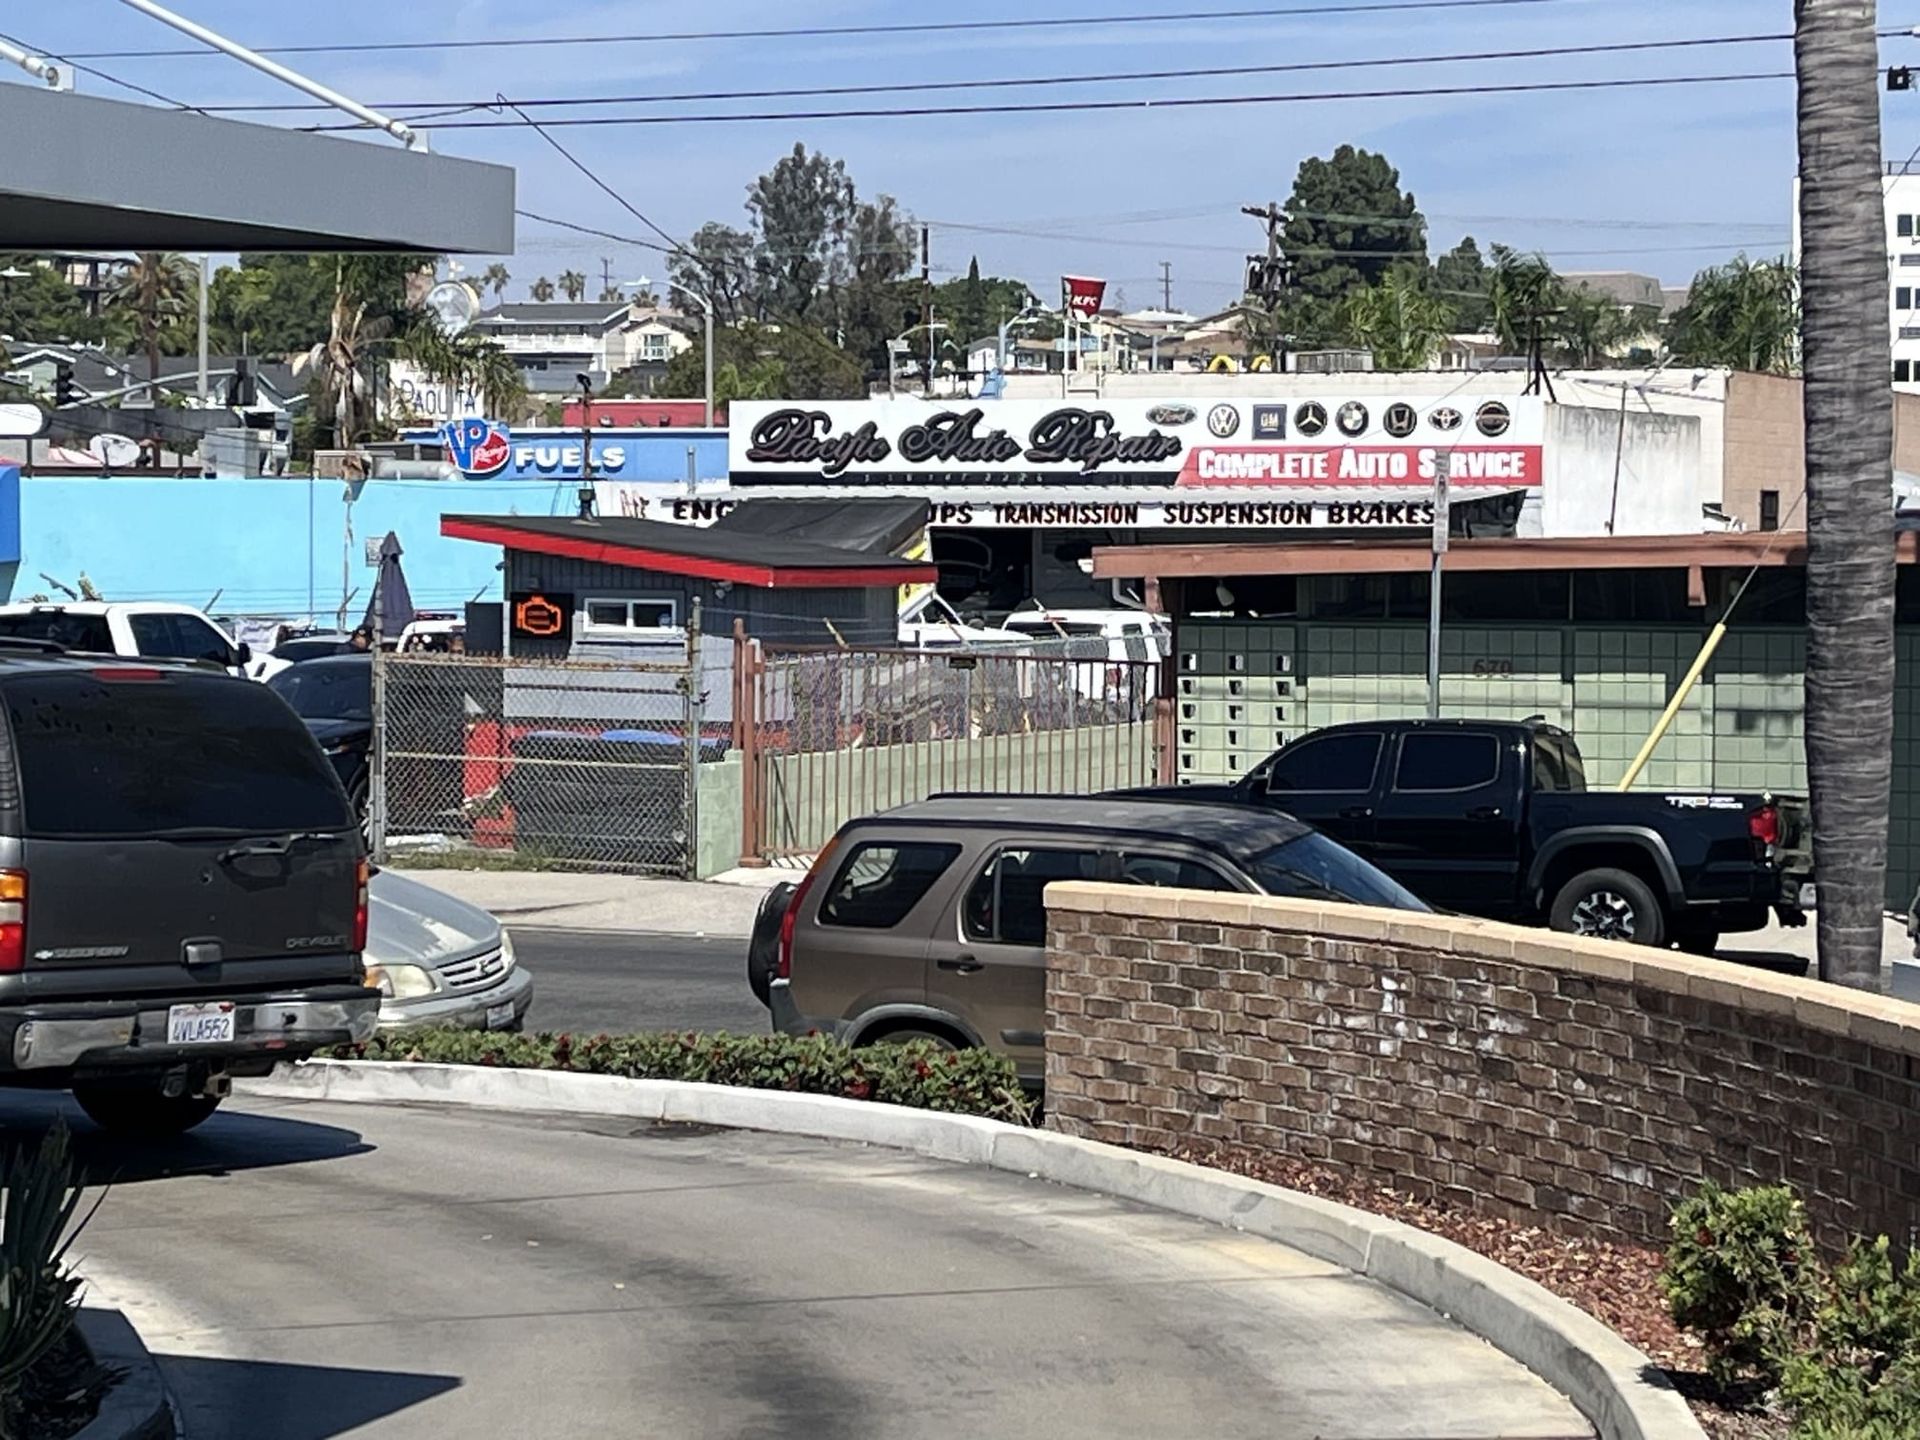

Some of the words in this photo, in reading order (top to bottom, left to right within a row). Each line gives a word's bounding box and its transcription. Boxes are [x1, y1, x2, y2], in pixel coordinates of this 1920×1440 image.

[1072, 294, 1098, 307] KFC
[445, 418, 490, 472] VP
[745, 408, 891, 475] Pacific
[897, 408, 1023, 463] Auto
[1024, 407, 1183, 473] Repair
[515, 447, 626, 470] FUELS
[1198, 449, 1329, 479] COMPLETE
[1338, 449, 1408, 478] AUTO
[1418, 449, 1525, 479] SRVICE
[993, 502, 1139, 525] TRANSMISSION
[1163, 502, 1313, 525] SUSPENSION
[1327, 502, 1435, 525] BRAKES
